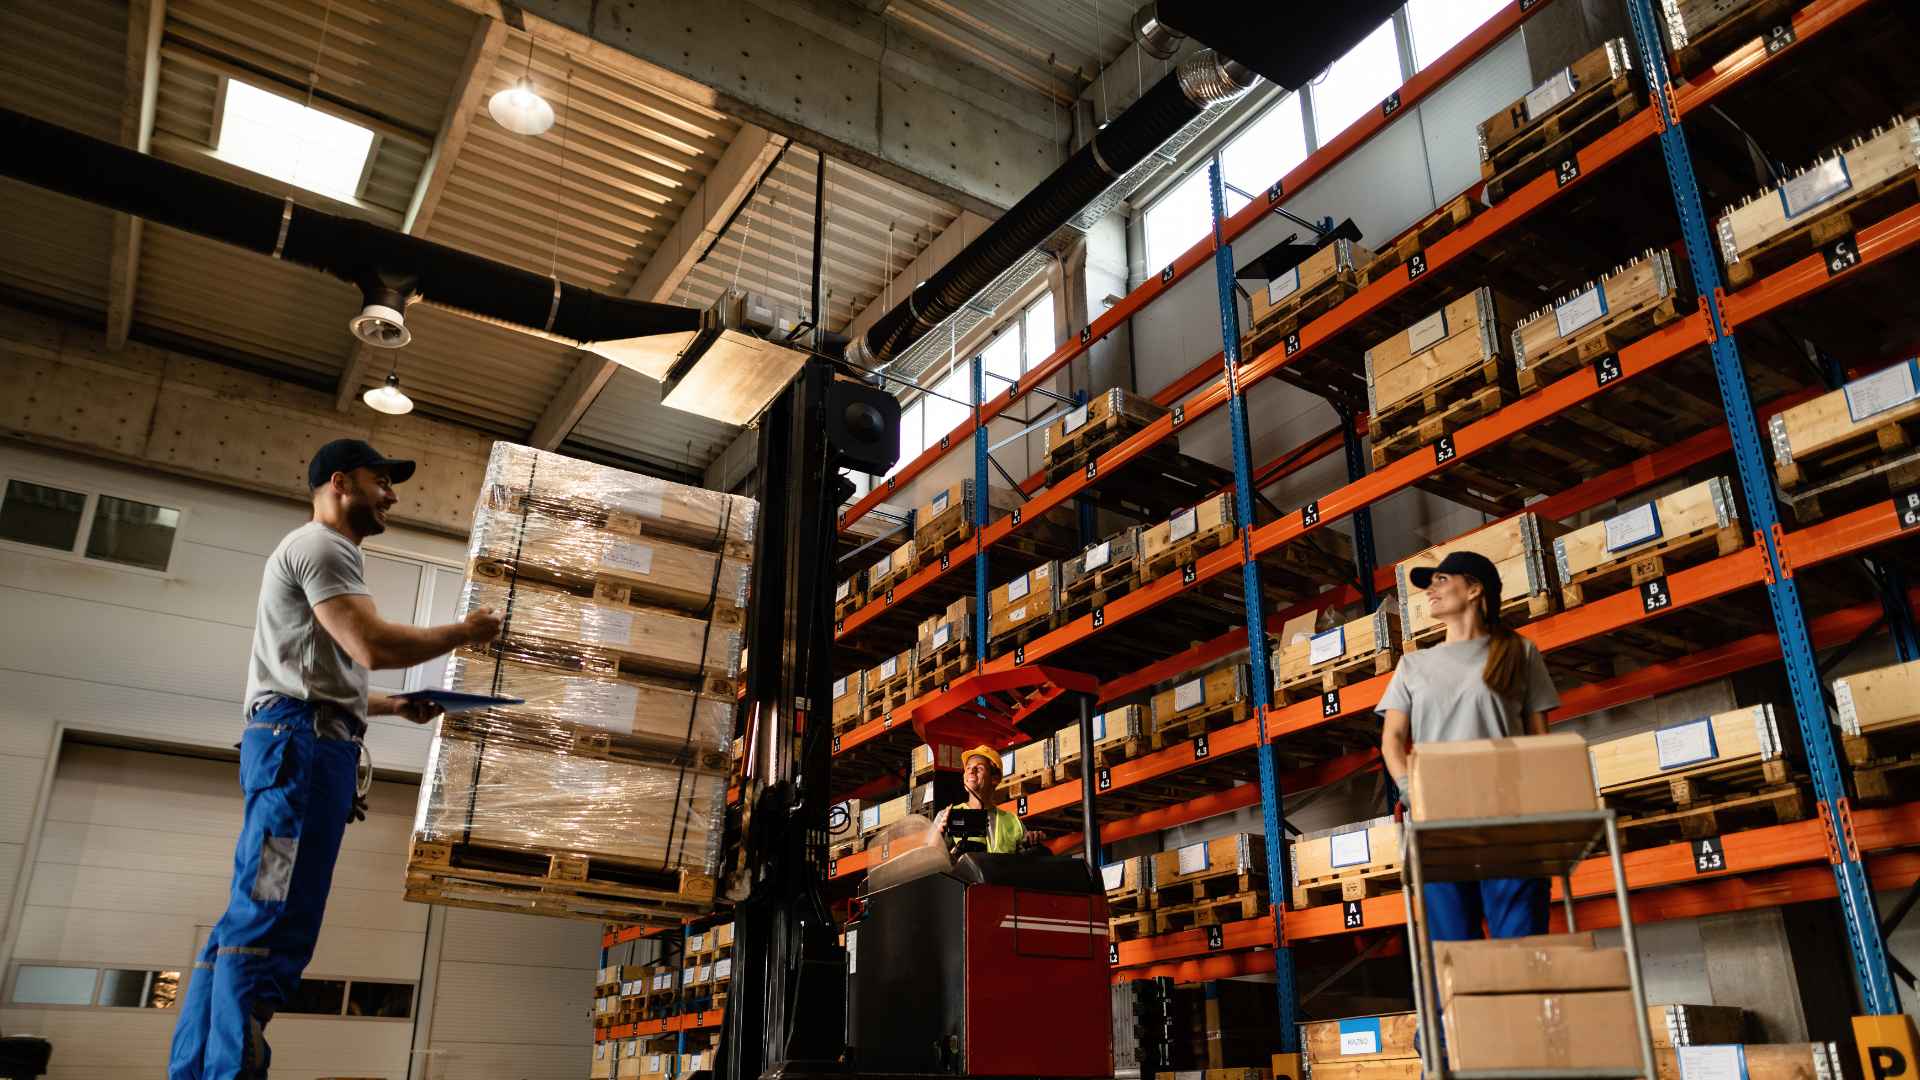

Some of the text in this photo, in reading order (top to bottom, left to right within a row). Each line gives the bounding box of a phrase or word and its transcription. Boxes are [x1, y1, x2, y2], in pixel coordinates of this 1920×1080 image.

[1772, 26, 1784, 38] D
[1770, 31, 1792, 52] 6.1
[1510, 102, 1530, 128] H
[1562, 161, 1571, 170] D
[1560, 168, 1577, 184] 5.3
[1835, 242, 1846, 255] C
[1413, 256, 1420, 265] D
[1832, 252, 1855, 271] 6.1
[1411, 264, 1425, 278] 5.2
[1289, 335, 1295, 343] D
[1287, 341, 1299, 354] 5.1
[1602, 358, 1610, 368] C
[1600, 366, 1618, 383] 5.3
[1174, 414, 1184, 425] 4.3
[1440, 439, 1447, 449] C
[1438, 448, 1454, 462] 5.2
[1907, 493, 1920, 508] B
[1307, 504, 1313, 513] C
[1305, 513, 1317, 525] 5.1
[1649, 582, 1658, 595] B
[1647, 594, 1667, 609] 5.3
[1094, 618, 1103, 626] 4.2
[1328, 693, 1334, 702] B
[1325, 703, 1338, 715] 5.1
[1197, 748, 1207, 756] 4.3
[1101, 779, 1110, 788] 4.2
[1020, 798, 1024, 806] B
[1702, 840, 1713, 853] A
[1698, 855, 1721, 869] 5.3
[1349, 903, 1357, 913] A
[1347, 914, 1361, 925] 5.1
[1210, 938, 1221, 946] 4.3
[1868, 1046, 1907, 1080] P
